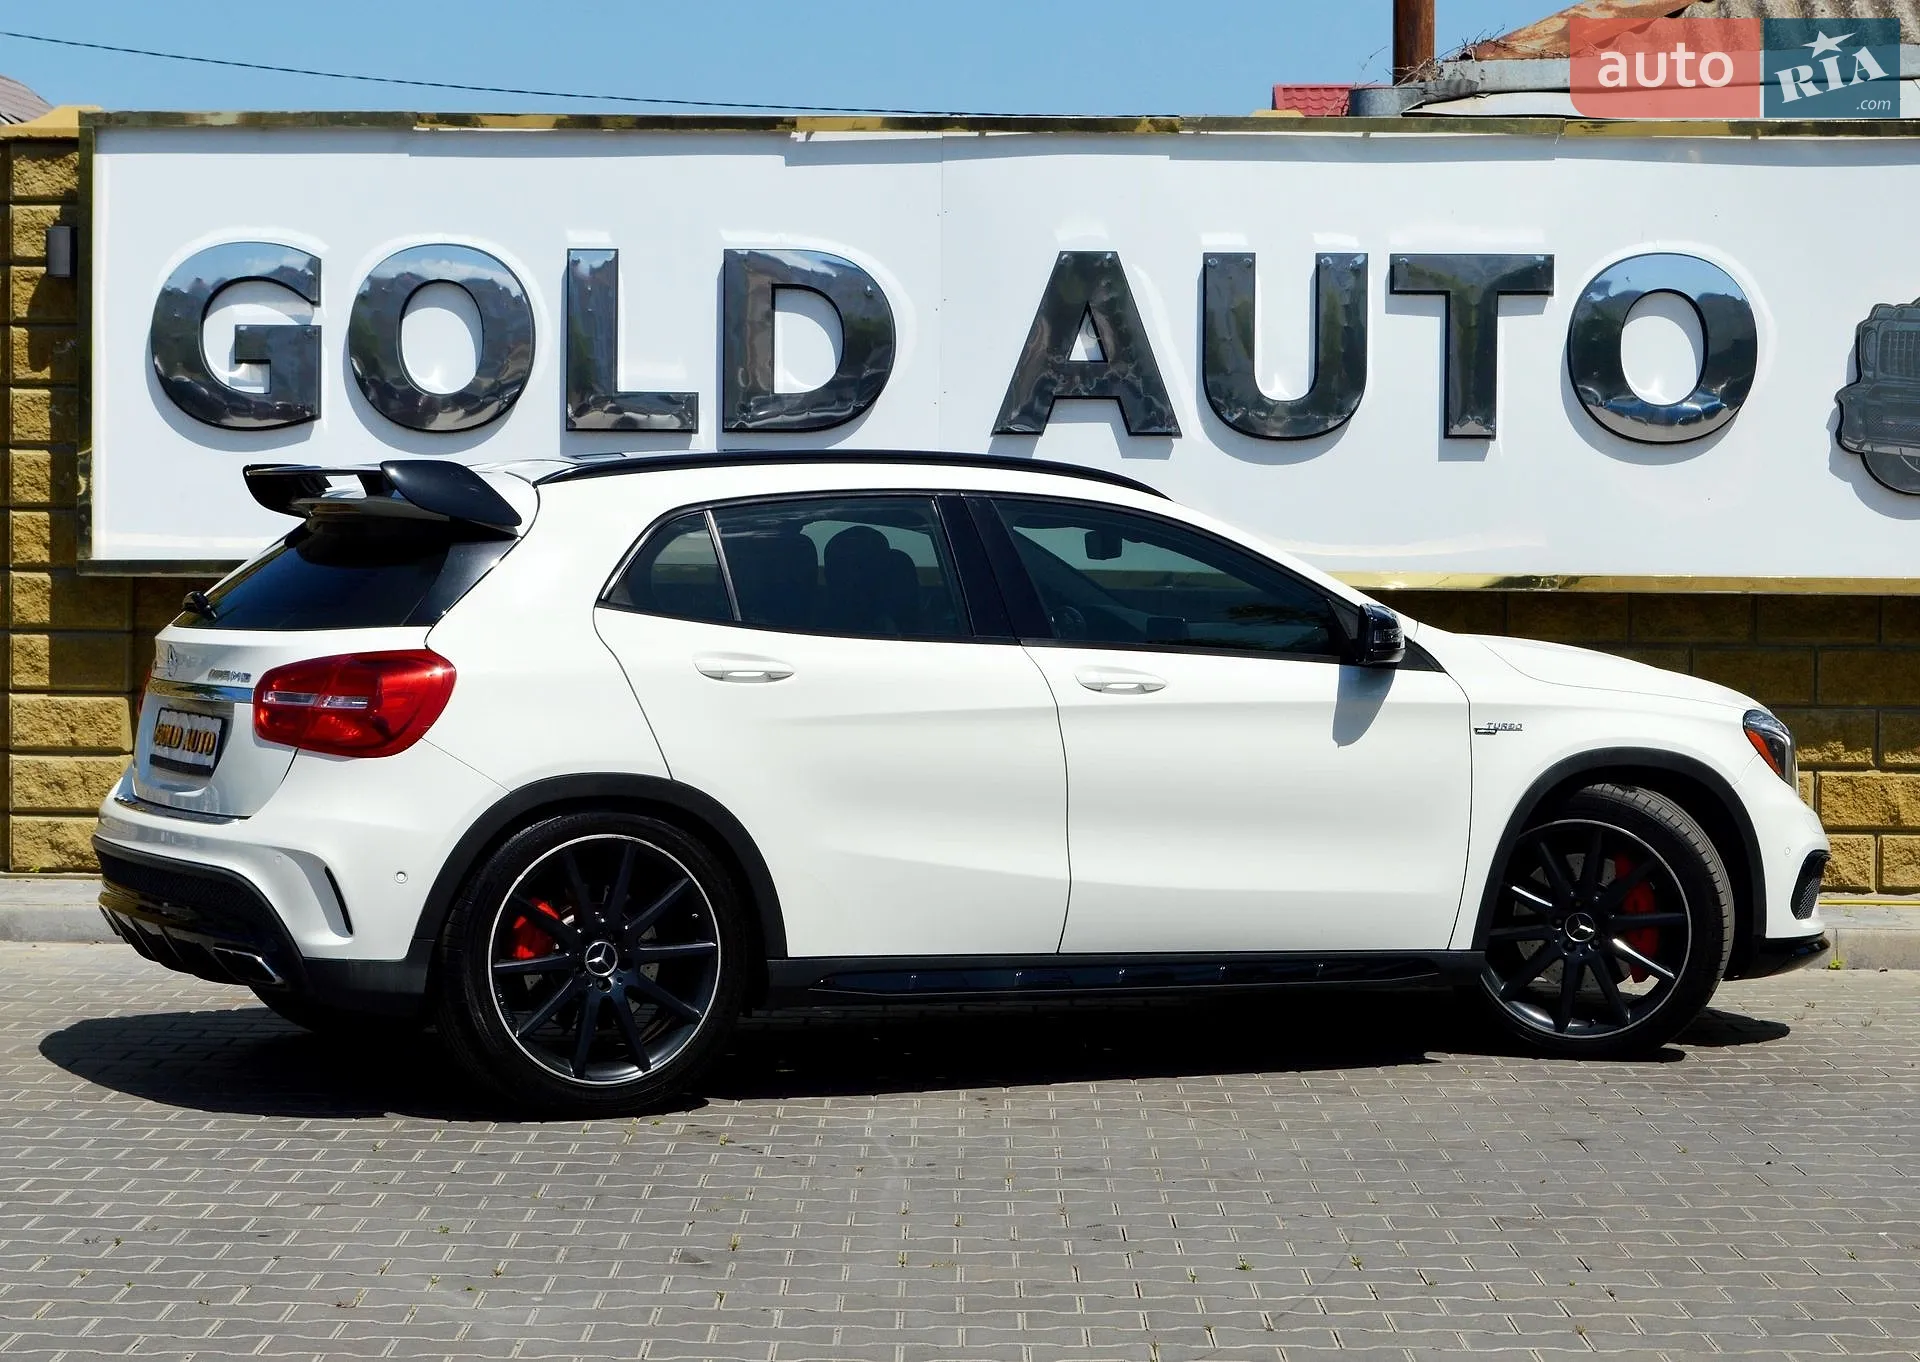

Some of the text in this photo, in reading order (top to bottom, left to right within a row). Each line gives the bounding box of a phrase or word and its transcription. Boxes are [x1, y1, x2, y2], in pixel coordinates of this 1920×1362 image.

[149, 241, 1758, 444] GOLD AUTO
[1486, 722, 1523, 731] TURBO
[182, 728, 217, 756] AUTO
